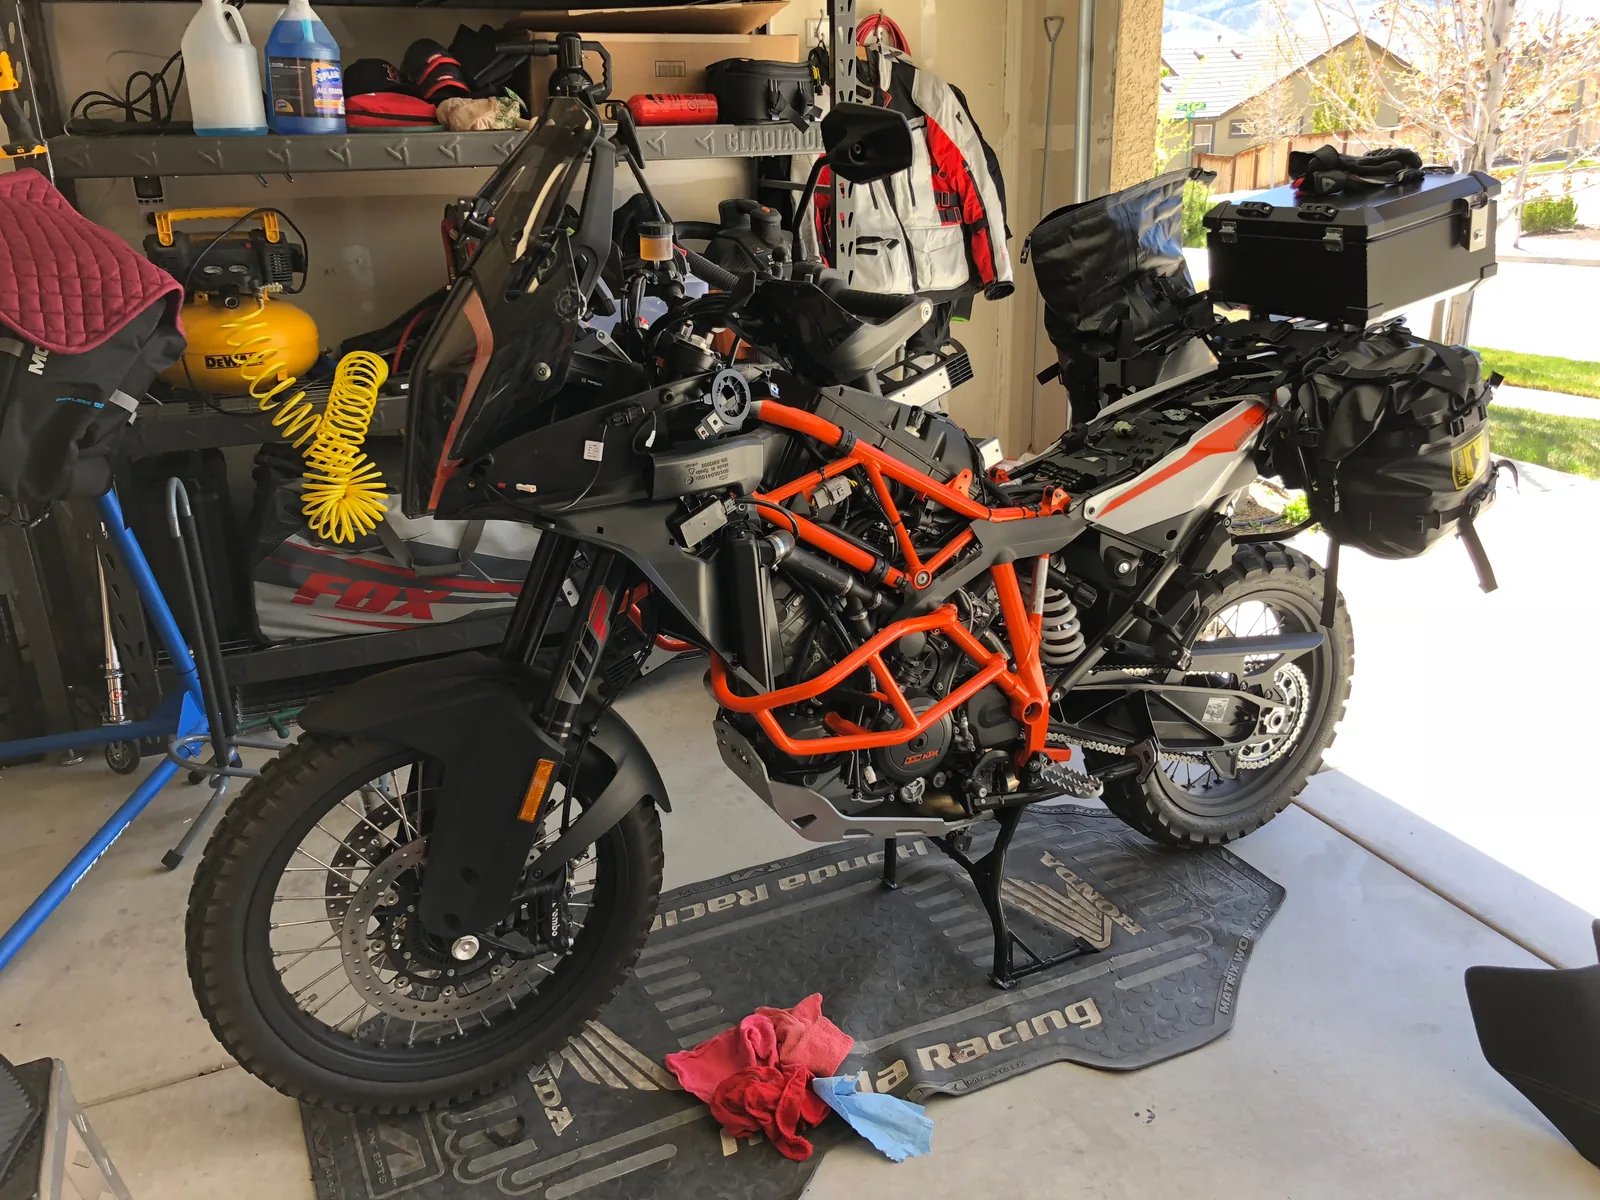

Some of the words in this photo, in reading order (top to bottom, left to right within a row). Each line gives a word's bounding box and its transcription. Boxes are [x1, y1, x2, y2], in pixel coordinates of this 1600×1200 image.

[290, 572, 451, 621] FOX
[551, 902, 560, 937] embo
[648, 883, 770, 933] Raci
[1040, 850, 1148, 936] HONDA
[1218, 963, 1241, 1015] MATRIX
[1232, 927, 1257, 962] WORK
[1250, 903, 1273, 929] MAT
[916, 997, 1102, 1072] Racing
[526, 1060, 576, 1138] NDA
